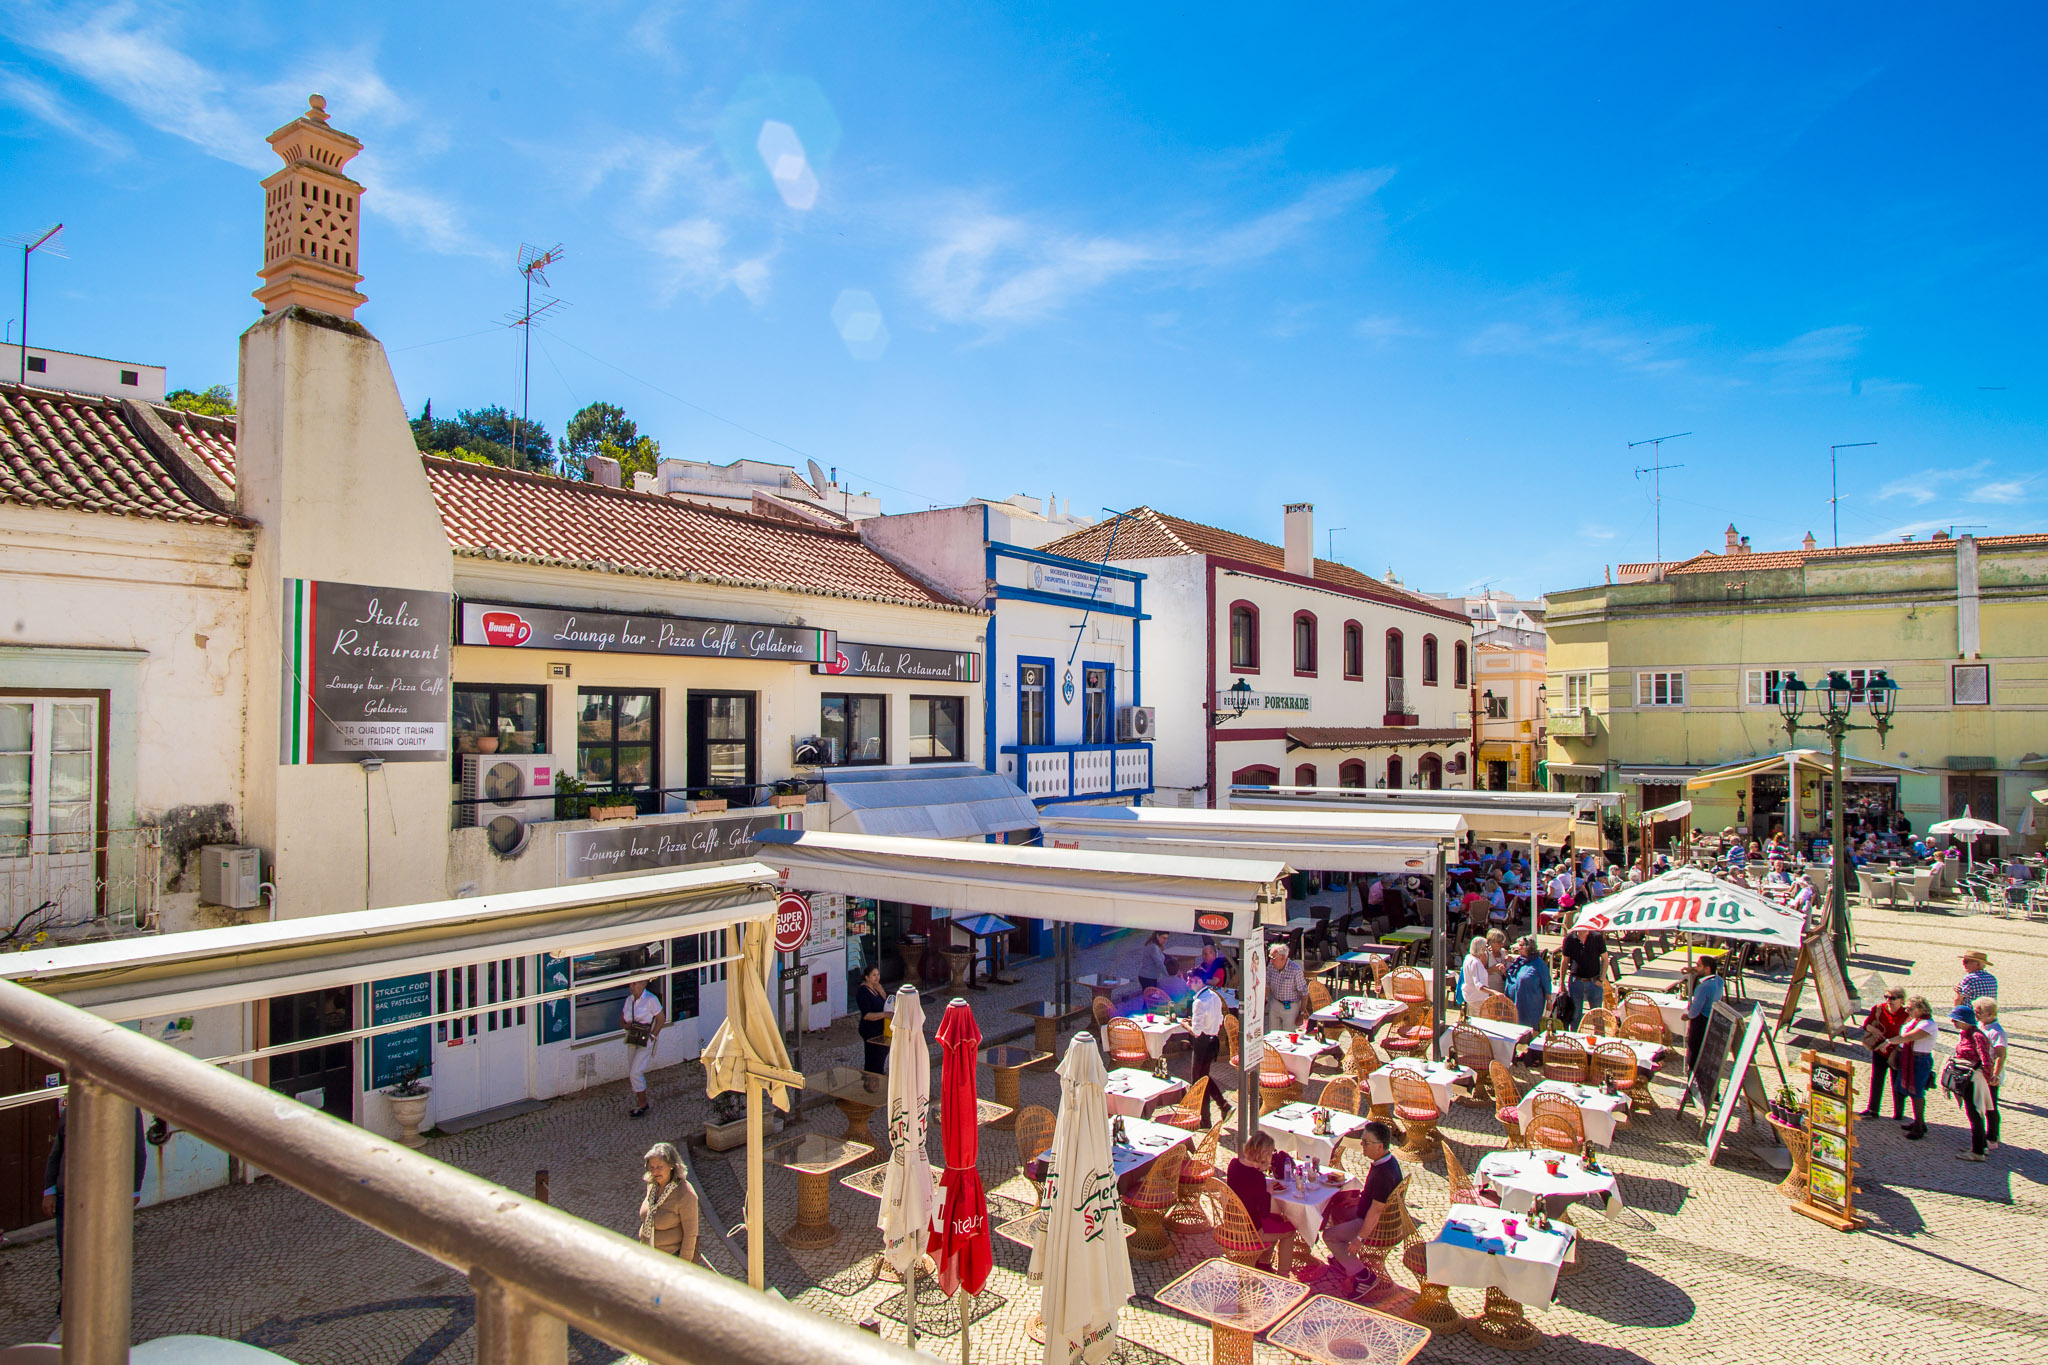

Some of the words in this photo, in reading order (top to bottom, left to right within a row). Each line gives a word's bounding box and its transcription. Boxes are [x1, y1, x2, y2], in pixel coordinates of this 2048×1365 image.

[355, 598, 420, 627] Italia
[488, 621, 516, 633] Buondi
[331, 628, 440, 660] Restaurant
[553, 616, 616, 650] Lounge
[621, 619, 646, 644] bar
[658, 623, 696, 648] Pizza
[750, 628, 804, 657] Gelateria
[854, 650, 891, 674] Italia
[896, 653, 952, 676] Restaurant
[325, 675, 364, 694] Lounge
[367, 676, 384, 690] bar
[390, 678, 417, 692] Pizza
[364, 698, 408, 717] Gelateria
[1264, 696, 1310, 710] PORTARADE
[336, 726, 355, 734] ALTA
[358, 726, 402, 735] QUALIDADE
[404, 726, 434, 734] ITALIANA
[344, 738, 365, 746] HIGH
[368, 738, 394, 746] ITALIAN
[397, 738, 427, 746] QUALITY
[580, 842, 626, 864] Lounge
[630, 838, 650, 858] bar
[658, 835, 688, 856] Pizza
[776, 910, 802, 924] SUPER
[776, 921, 802, 934] BOCK
[375, 984, 406, 998] STREET
[408, 981, 430, 991] FOOD
[375, 1002, 389, 1010] BAR
[390, 994, 430, 1008] PASTELERIA
[382, 1016, 396, 1024] SELF
[397, 1011, 422, 1020] SERVICE
[387, 1040, 401, 1048] FAST
[387, 1052, 402, 1060] TAKE
[402, 1048, 419, 1056] AWAY
[1089, 1322, 1112, 1343] Miguel
